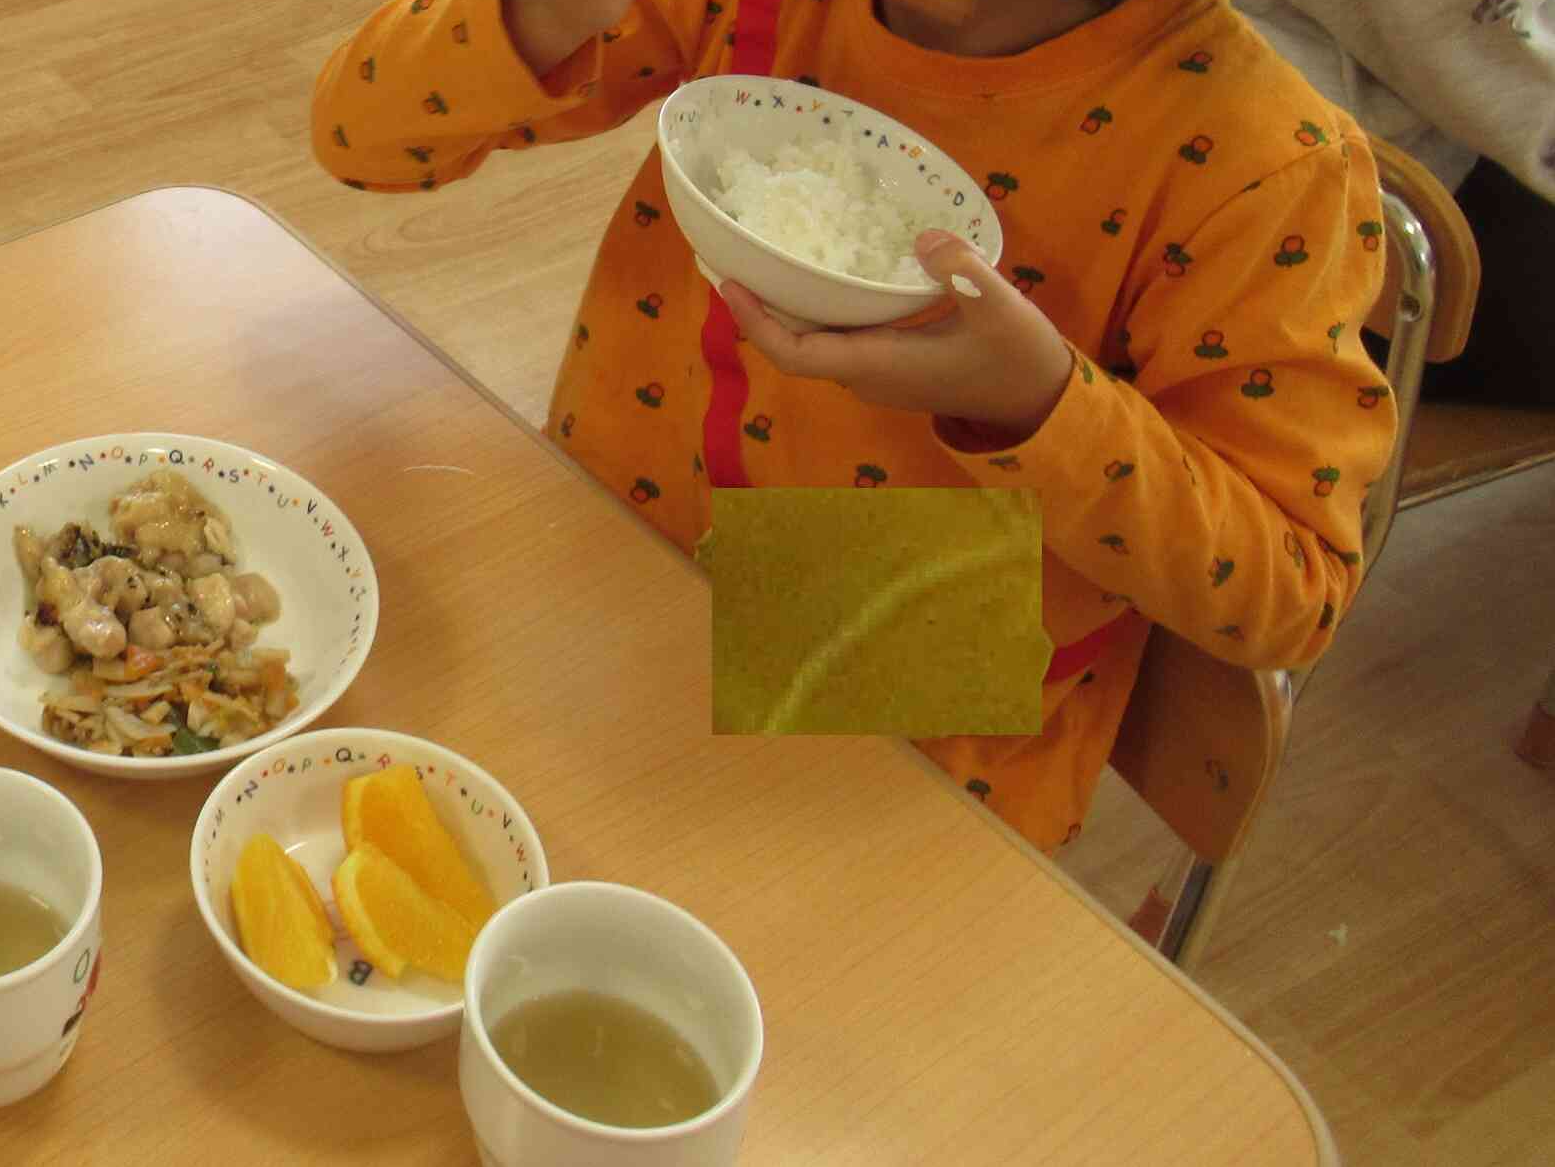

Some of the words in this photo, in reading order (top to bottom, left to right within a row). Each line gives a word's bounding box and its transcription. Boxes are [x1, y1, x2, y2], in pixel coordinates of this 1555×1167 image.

[773, 95, 784, 108] X
[877, 134, 889, 148] A
[953, 191, 964, 206] D
[79, 453, 95, 471] N
[111, 445, 124, 459] O
[169, 449, 185, 465] Q
[203, 457, 214, 473] R
[229, 469, 240, 483] S
[277, 493, 289, 508] U
[307, 498, 318, 514] V
[338, 545, 349, 562] X
[273, 758, 285, 774] O
[335, 747, 353, 763] Q
[377, 753, 390, 769] R
[470, 799, 484, 815] U
[503, 811, 513, 829] V
